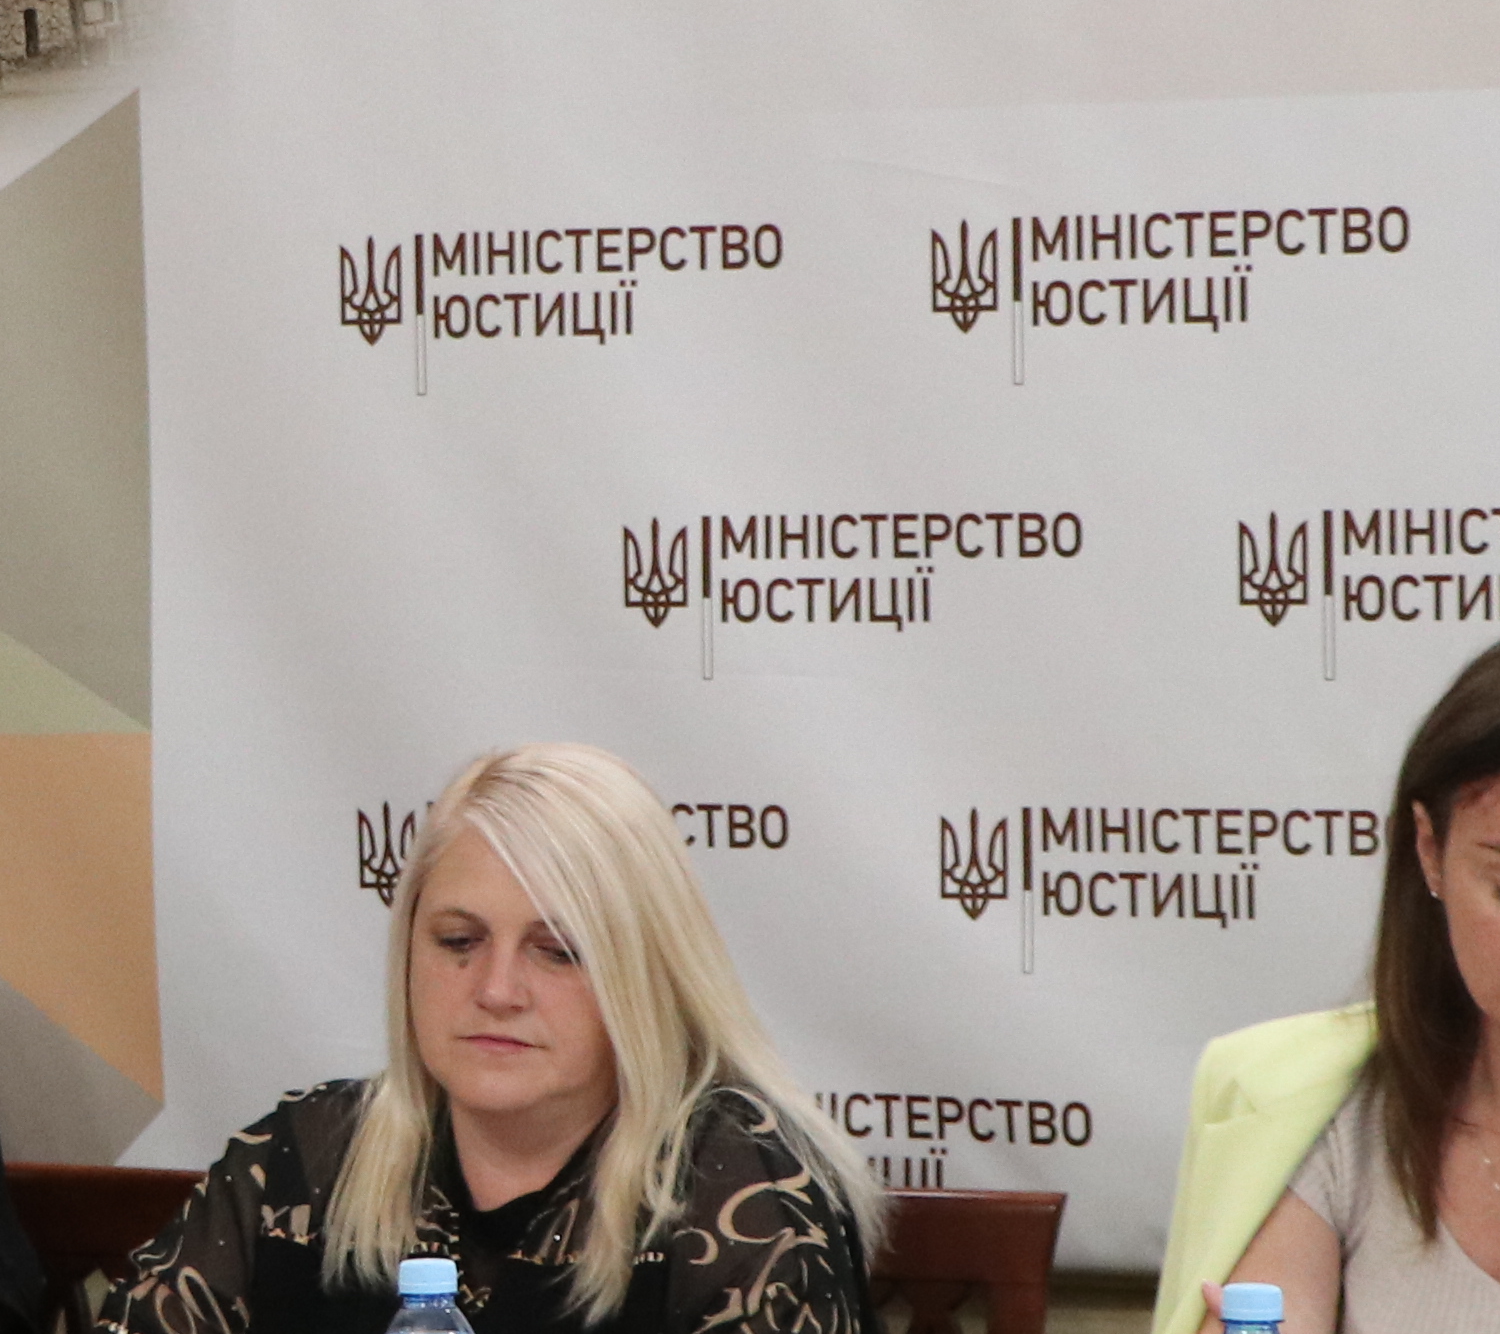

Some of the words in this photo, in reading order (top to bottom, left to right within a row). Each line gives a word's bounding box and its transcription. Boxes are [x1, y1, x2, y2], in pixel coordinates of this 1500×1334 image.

[431, 223, 783, 278] МІНІСТЕРСТВО
[1031, 207, 1410, 262] МІНІСТЕРСТВО
[432, 280, 634, 345] ЮСТИЦІЇ
[1031, 267, 1250, 333] ЮСТИЦІЇ
[719, 513, 1083, 562] МІНІСТЕРСТВО
[720, 567, 931, 632] ЮСТИЦІЇ
[1041, 807, 1380, 856] МІНІСТЕРСТВ
[1042, 862, 1260, 929] ЮСТИЦІЇ
